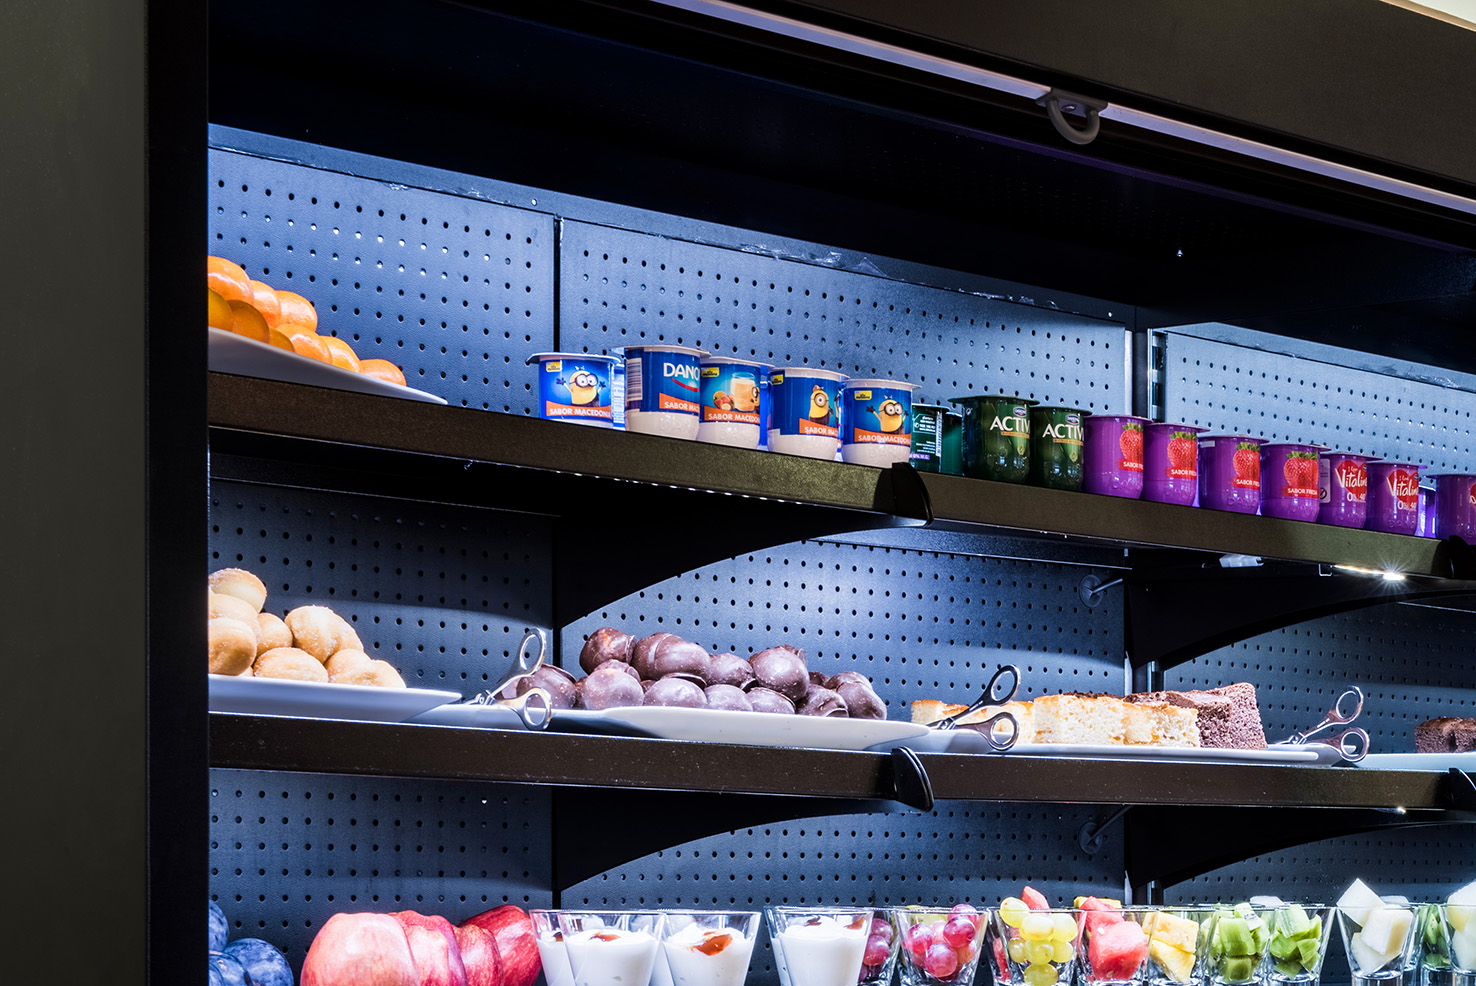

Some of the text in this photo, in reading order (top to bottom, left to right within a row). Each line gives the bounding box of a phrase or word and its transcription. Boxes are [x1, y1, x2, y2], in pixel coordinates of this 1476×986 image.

[664, 401, 688, 409] SABOR
[549, 407, 573, 415] SABOR
[708, 412, 733, 420] SABOR
[804, 426, 827, 434] SABOR
[1042, 423, 1084, 441] ACTIV
